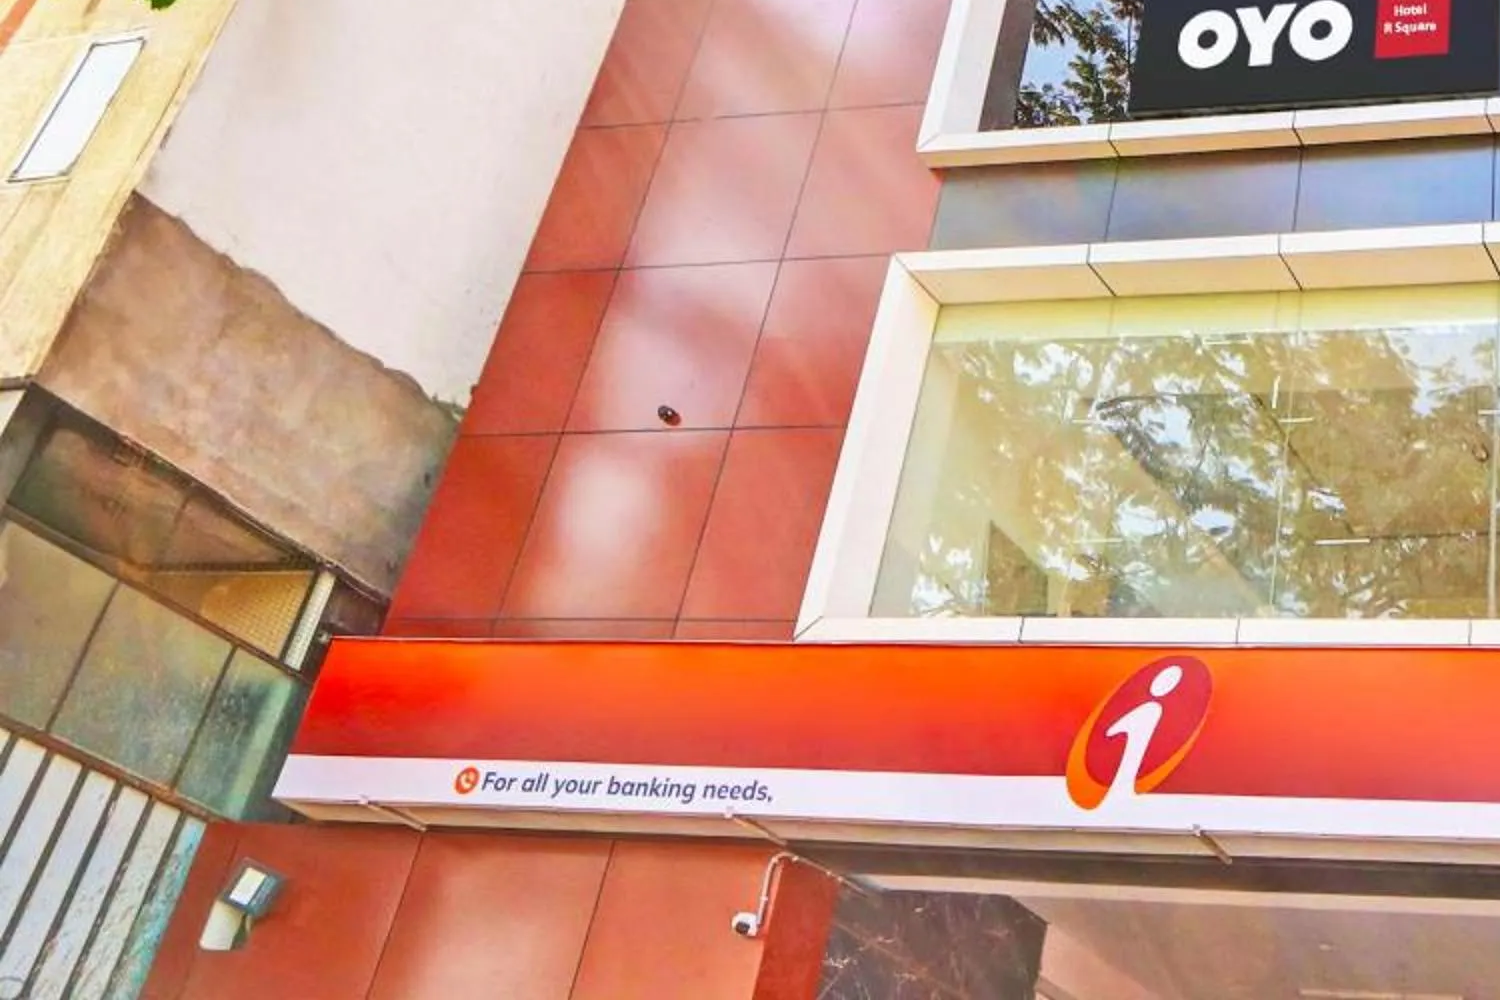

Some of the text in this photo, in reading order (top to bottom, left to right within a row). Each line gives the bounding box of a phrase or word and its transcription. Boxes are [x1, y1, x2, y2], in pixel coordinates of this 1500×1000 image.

[1393, 2, 1428, 17] Hotel
[1177, 0, 1354, 70] OYO
[1395, 20, 1437, 36] Square
[481, 771, 516, 793] For
[521, 772, 550, 795] all
[551, 778, 603, 799] your
[606, 776, 696, 804] banking
